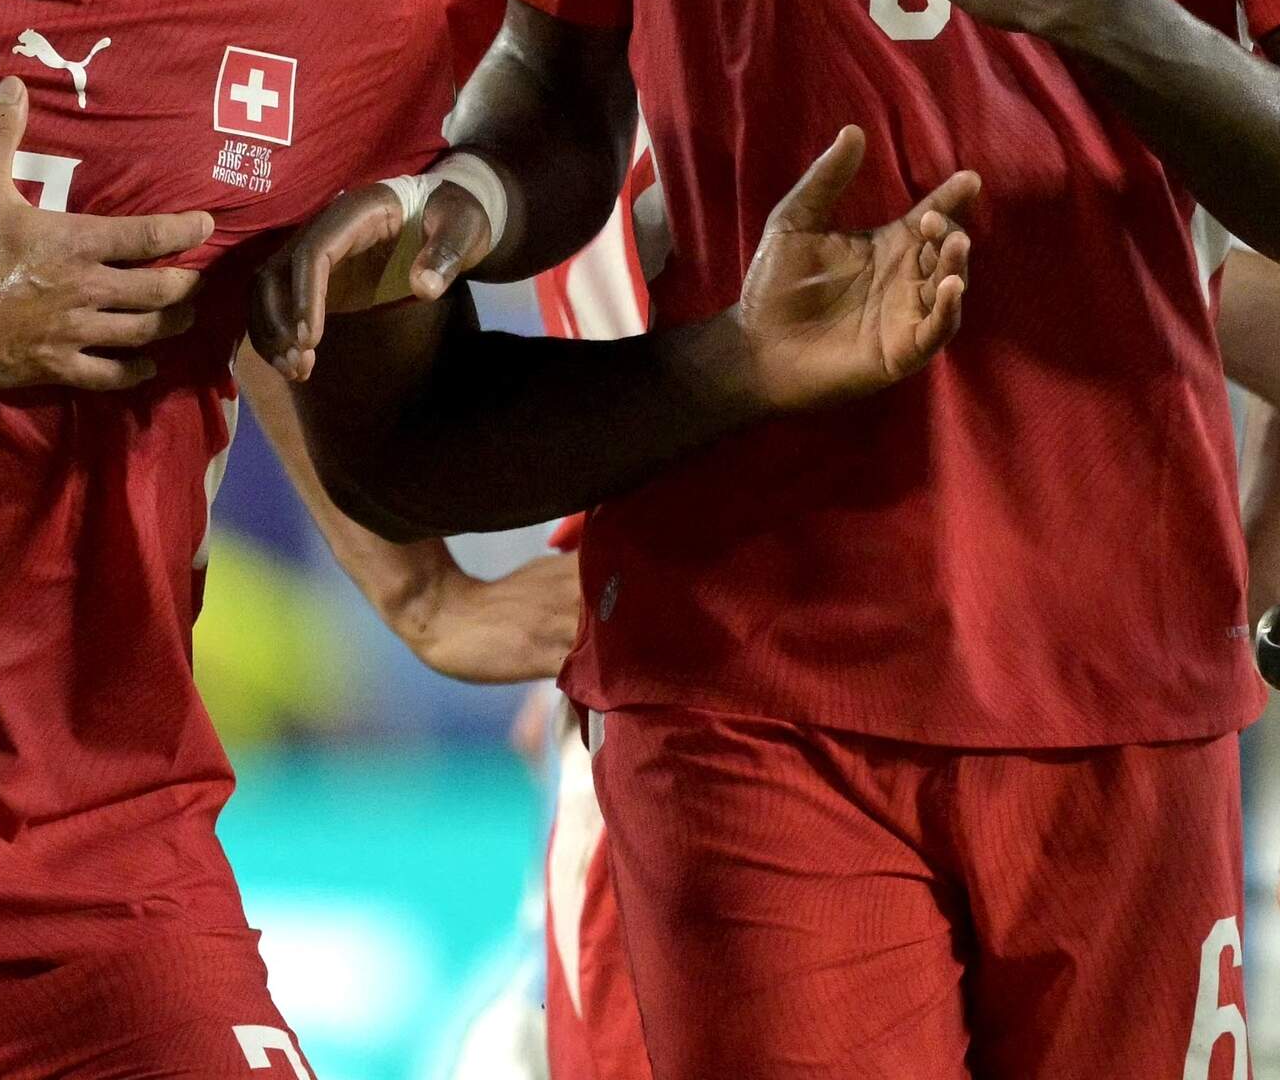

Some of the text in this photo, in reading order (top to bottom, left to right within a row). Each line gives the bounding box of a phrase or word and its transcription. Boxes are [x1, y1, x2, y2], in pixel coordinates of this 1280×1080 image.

[217, 150, 243, 171] ARG
[223, 139, 273, 162] 11.07.2026
[212, 165, 272, 193] KANSAS CITY
[1183, 915, 1248, 1080] 6
